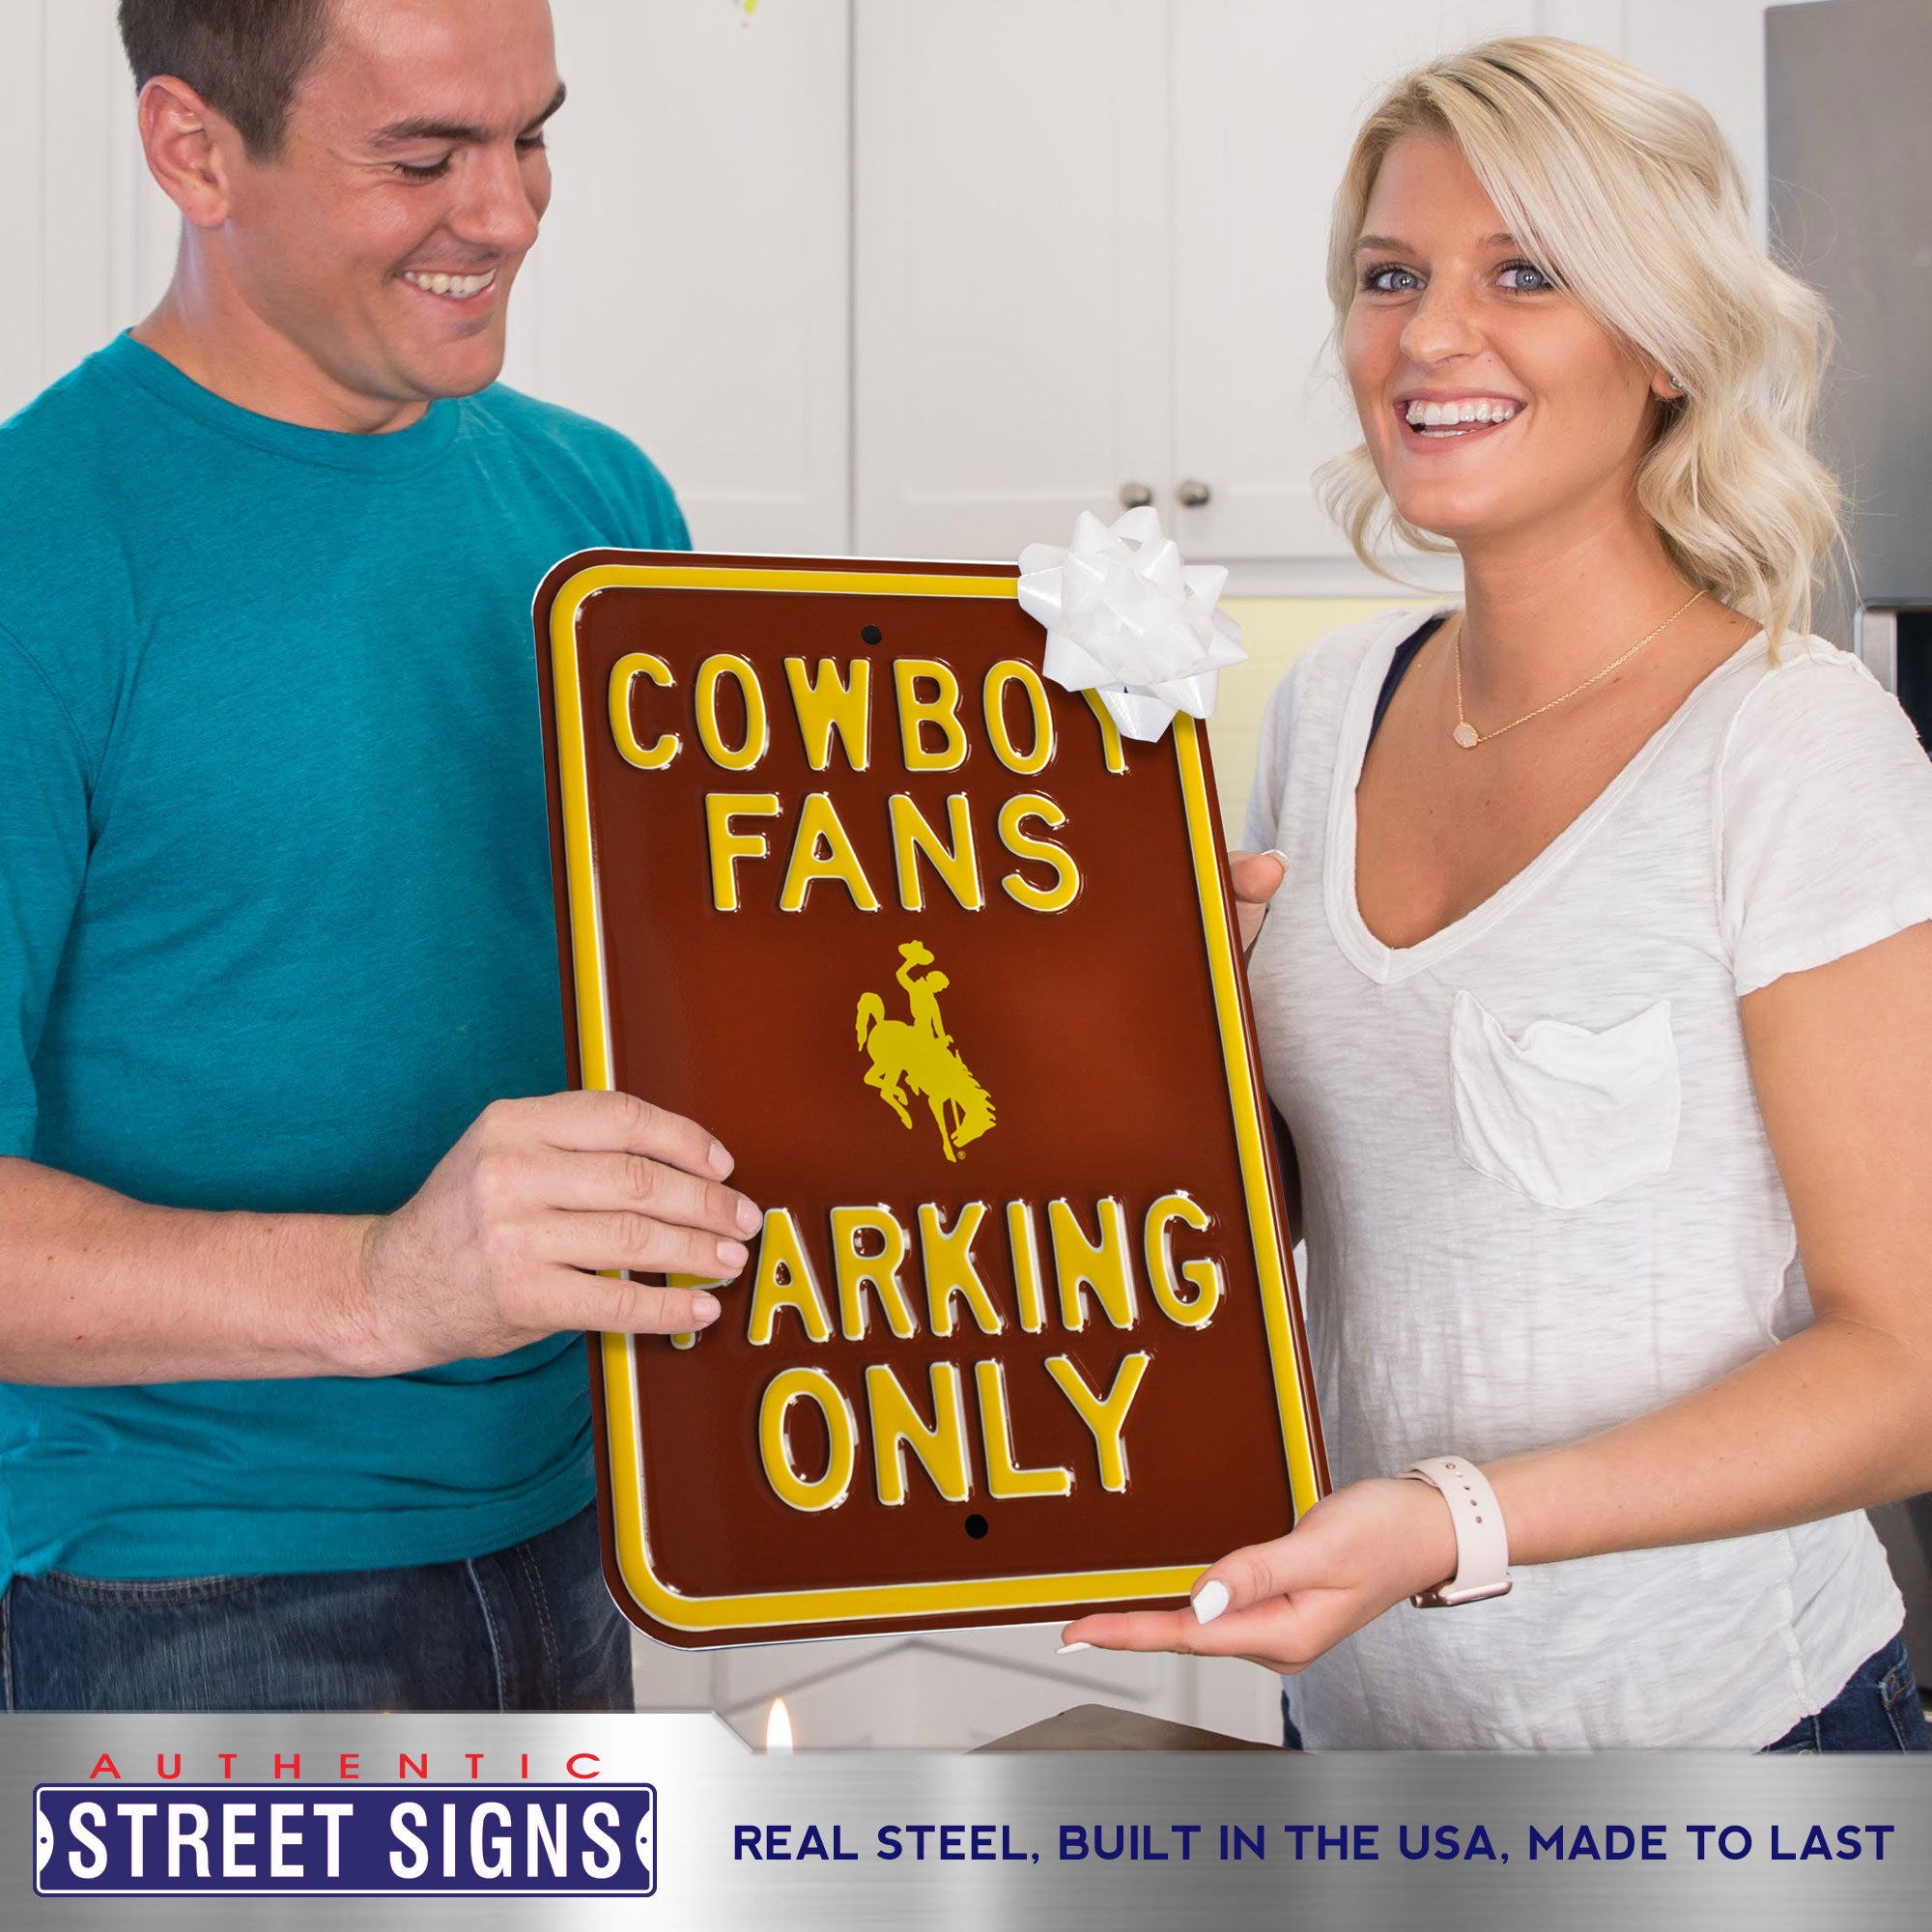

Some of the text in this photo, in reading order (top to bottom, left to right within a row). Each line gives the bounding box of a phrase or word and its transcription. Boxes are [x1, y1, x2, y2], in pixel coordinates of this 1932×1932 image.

[705, 790, 1083, 913] FANS
[666, 1190, 1225, 1350] ARKING
[758, 1350, 1153, 1513] ONLY
